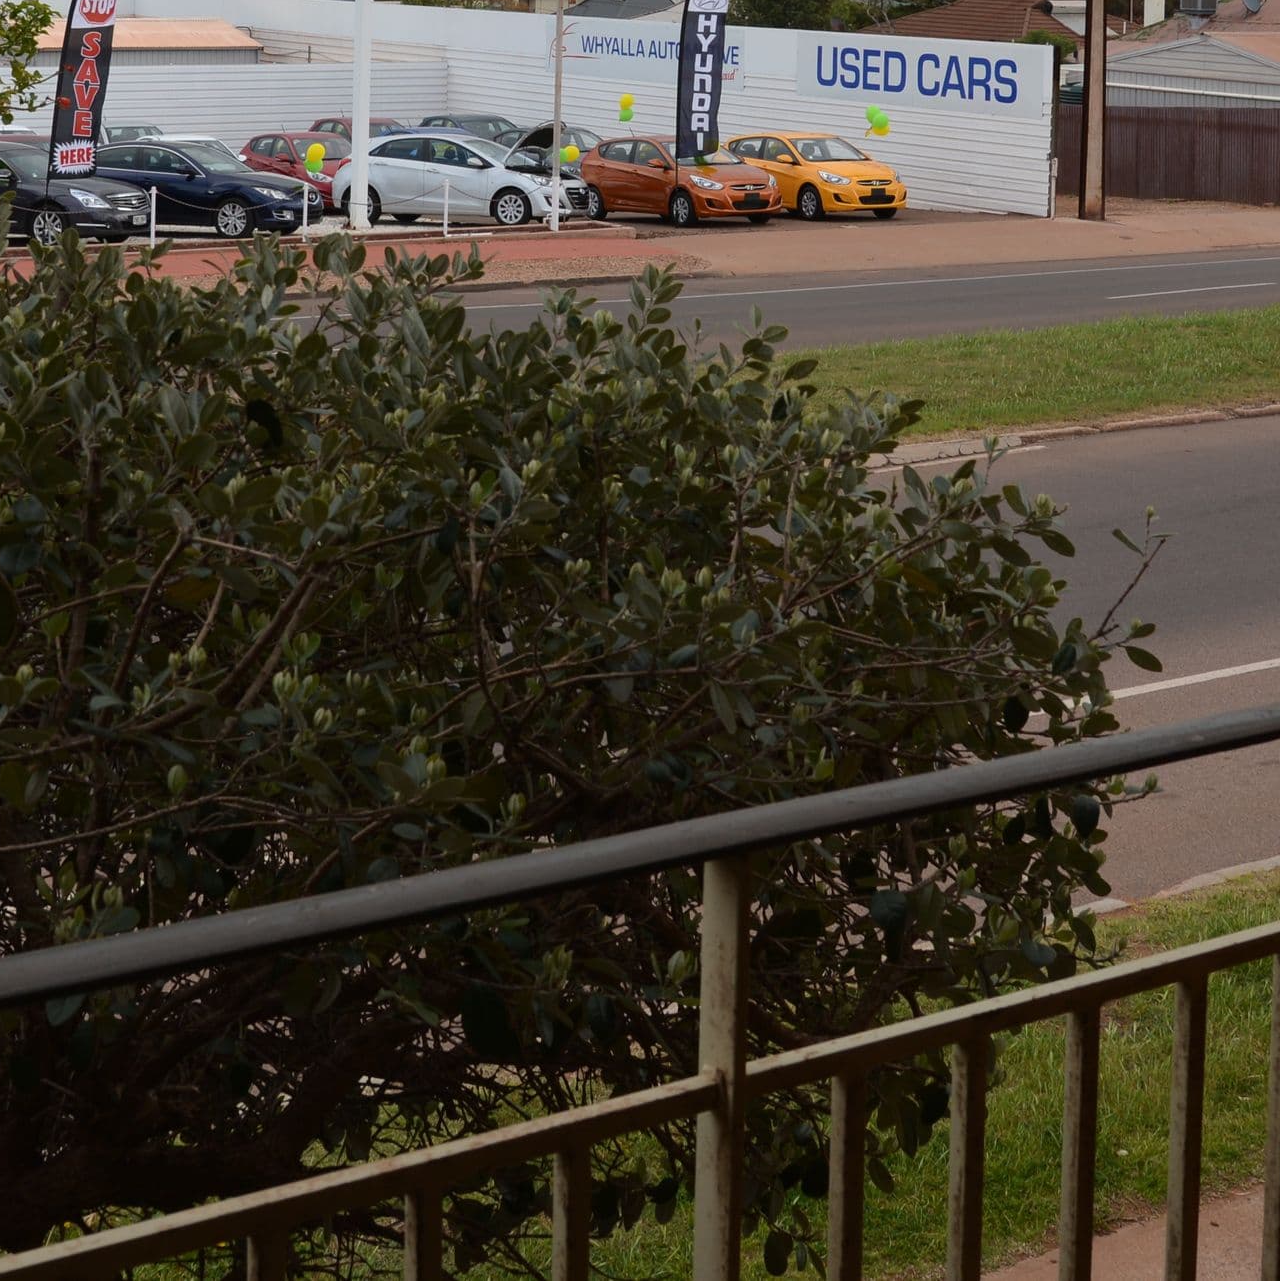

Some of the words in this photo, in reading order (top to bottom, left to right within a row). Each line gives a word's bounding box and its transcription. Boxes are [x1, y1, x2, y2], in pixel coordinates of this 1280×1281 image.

[73, 31, 102, 138] SAVE
[581, 35, 645, 58] WHYALLA
[648, 39, 740, 65] AUTOVE
[691, 14, 718, 151] HYUNDAI
[817, 45, 907, 93] USED
[917, 53, 1018, 104] CARS
